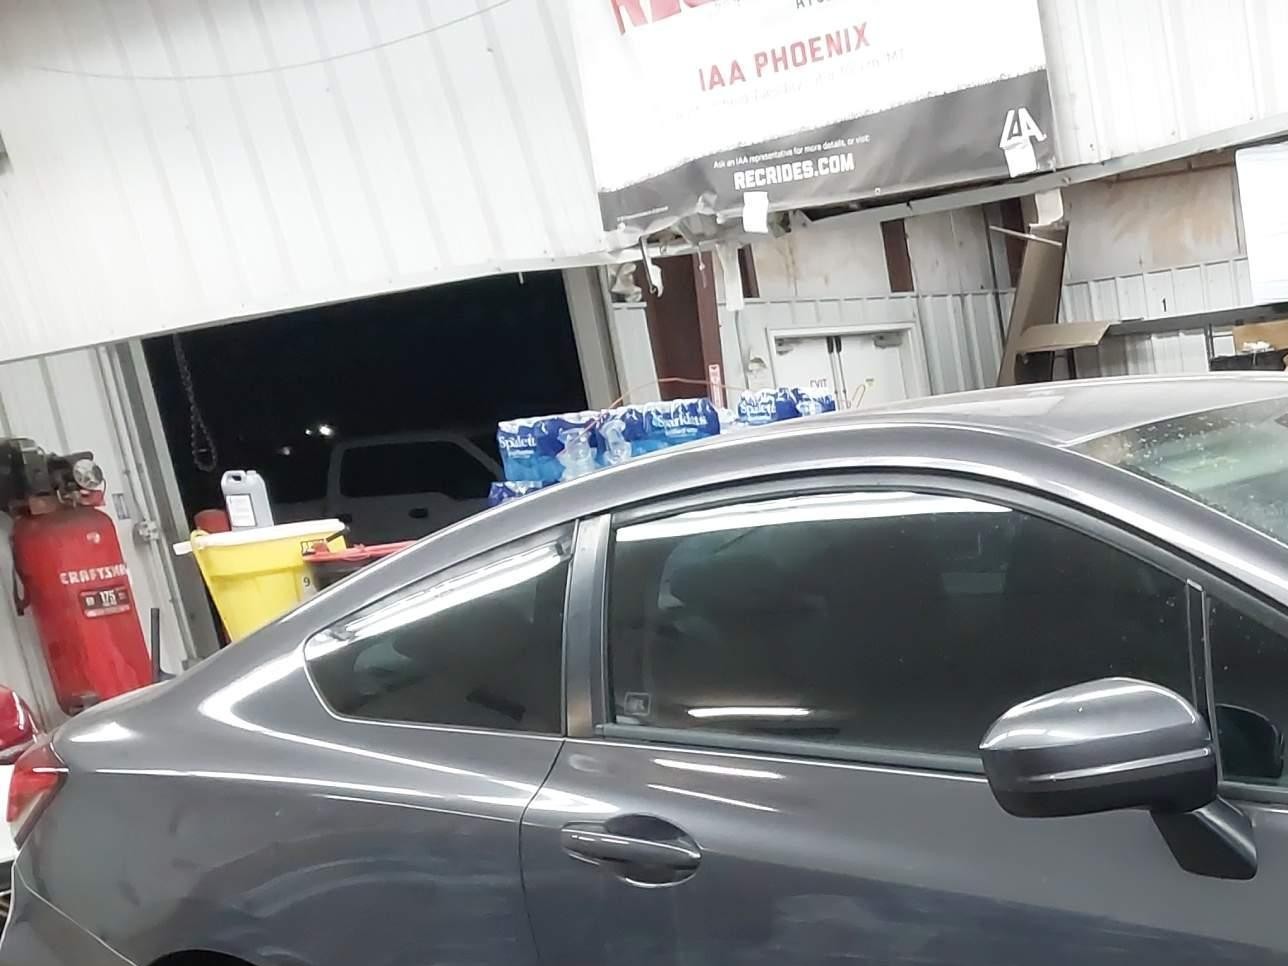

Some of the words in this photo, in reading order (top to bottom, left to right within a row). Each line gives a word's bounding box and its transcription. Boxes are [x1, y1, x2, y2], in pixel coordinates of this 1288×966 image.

[698, 60, 746, 92] IAA
[754, 22, 871, 78] PHOENIX
[713, 160, 725, 169] Ask
[736, 156, 748, 165] IAA
[749, 149, 793, 164] representative
[793, 147, 803, 155] for
[804, 144, 822, 153] more
[733, 153, 855, 191] RECRIDES.COM
[59, 563, 127, 585] CRAFTSMA
